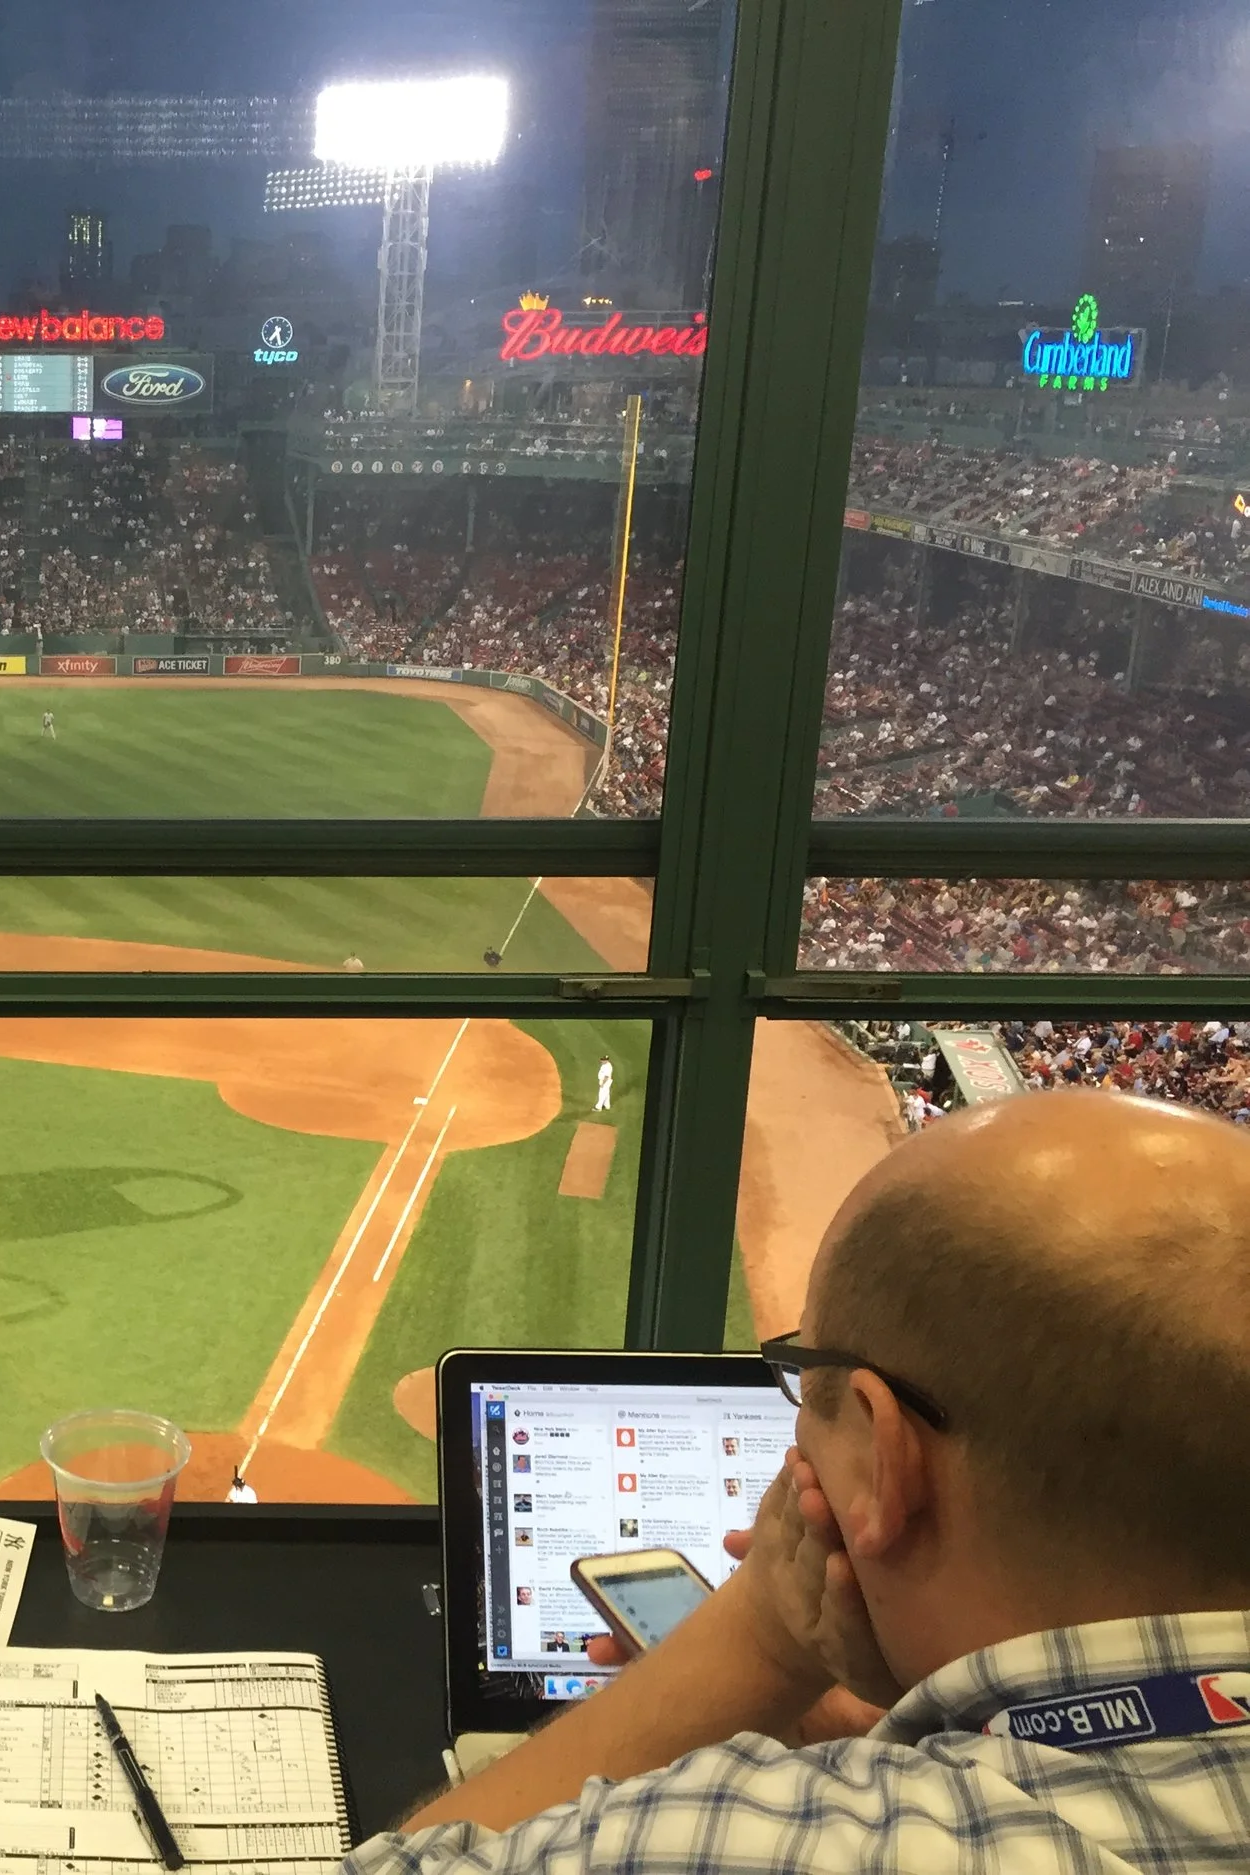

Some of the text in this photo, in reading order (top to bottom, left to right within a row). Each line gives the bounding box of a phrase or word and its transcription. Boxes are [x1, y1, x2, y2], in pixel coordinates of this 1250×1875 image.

[41, 309, 165, 342] balance
[500, 307, 709, 361] Budweis
[253, 347, 298, 366] tyco
[1022, 329, 1133, 378] Cumberland
[122, 369, 184, 398] Ford
[1038, 375, 1110, 392] FARMS
[1138, 576, 1161, 595] ALEX
[1162, 583, 1184, 601] AND
[57, 658, 99, 673] xfinity
[158, 660, 176, 670] ACE
[177, 660, 207, 670] TICKET
[323, 655, 342, 665] 380
[395, 665, 422, 677] TOYO
[628, 1411, 660, 1419] Mentions
[733, 1413, 762, 1421] Yankees
[1012, 1696, 1142, 1737] MLB.com
